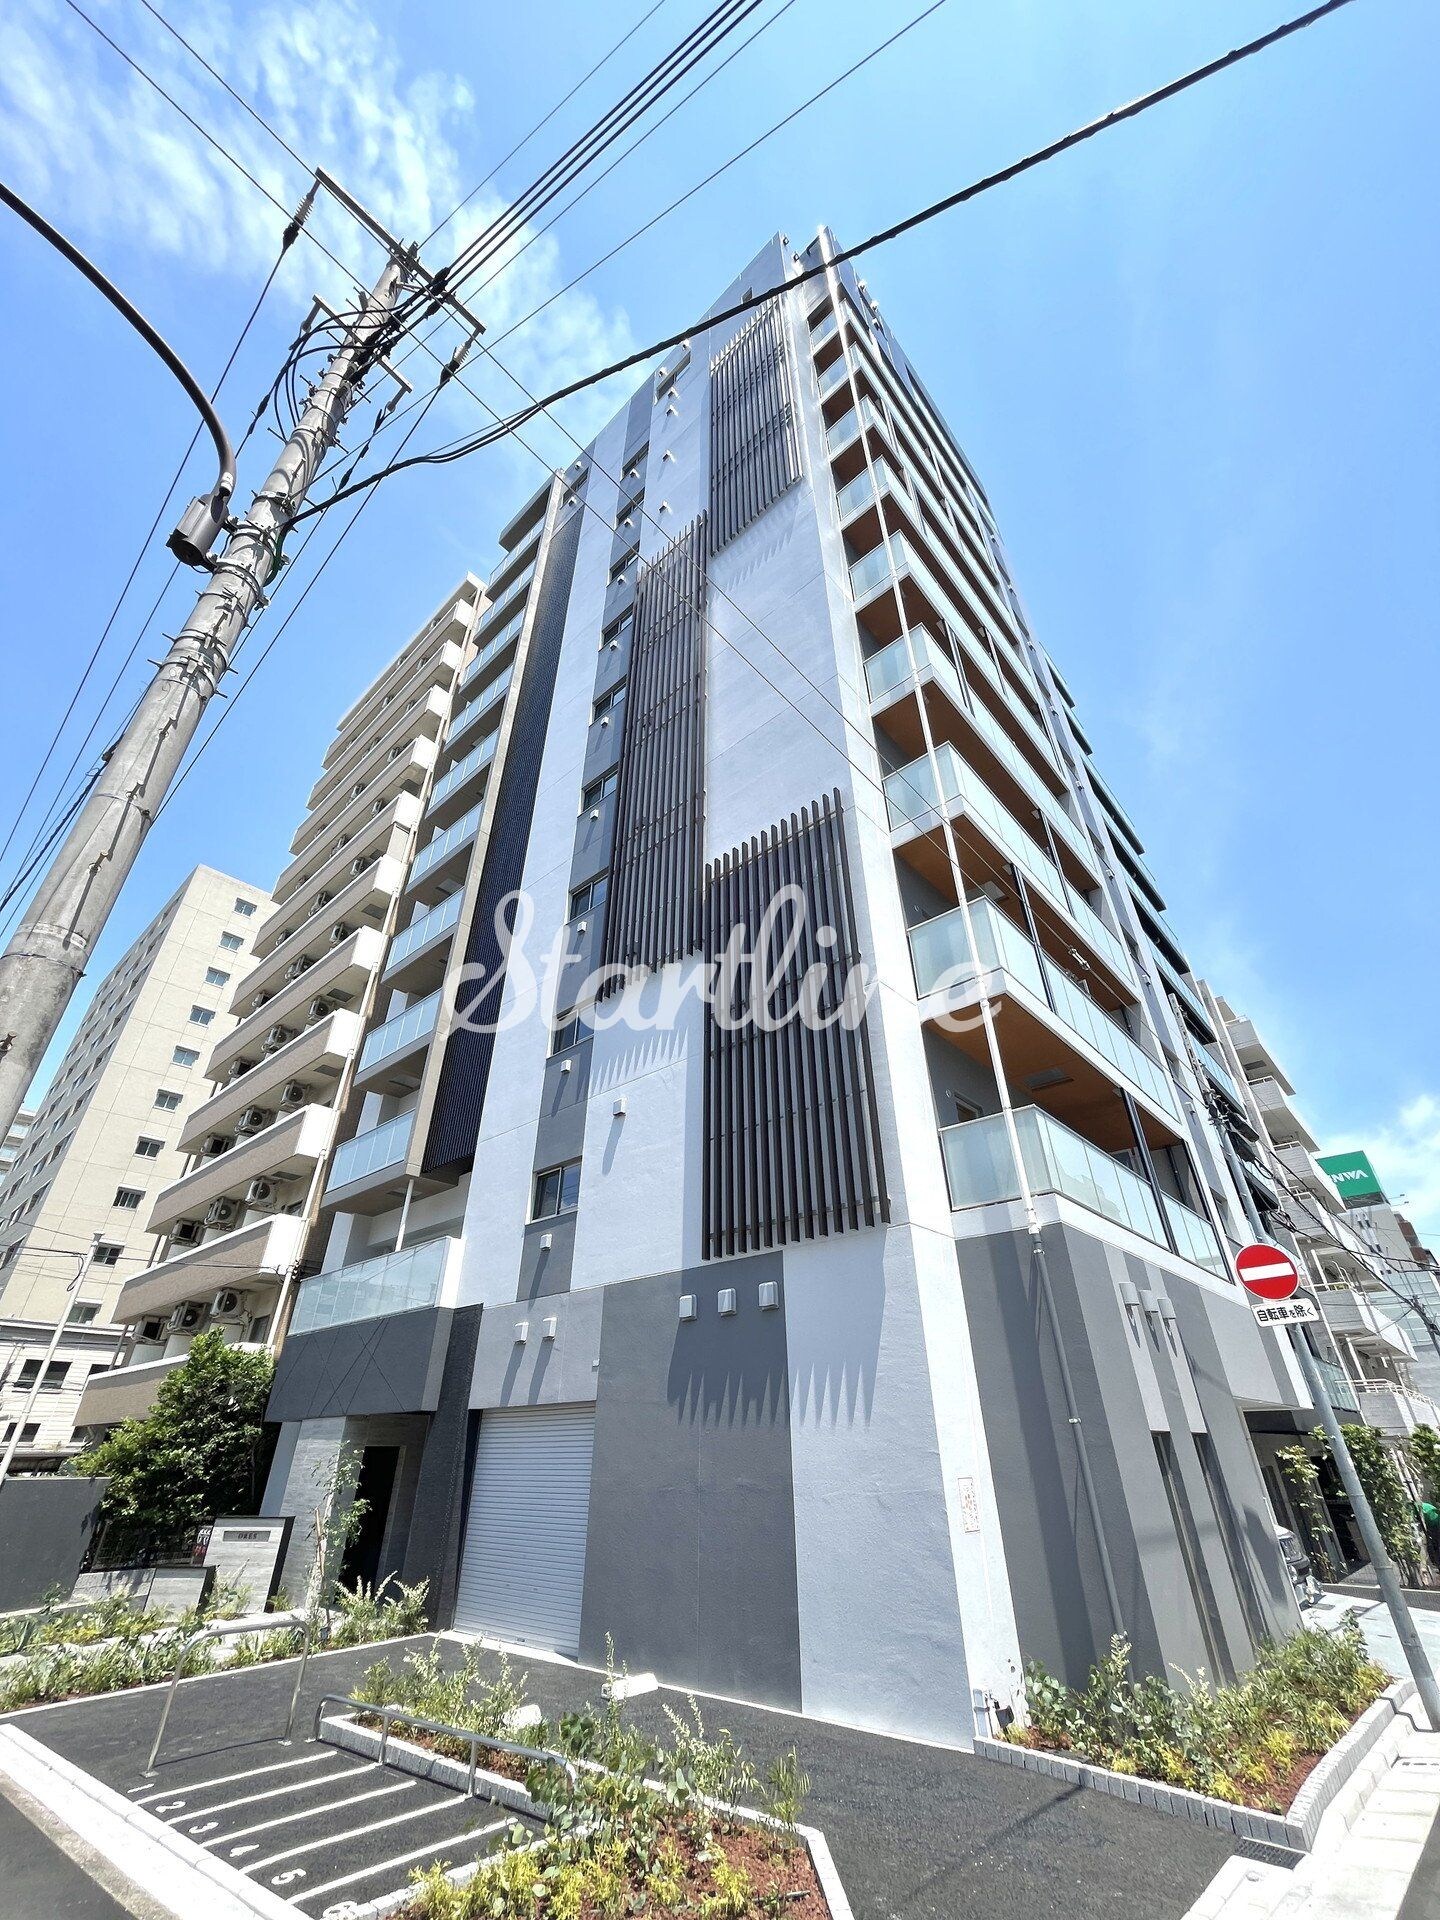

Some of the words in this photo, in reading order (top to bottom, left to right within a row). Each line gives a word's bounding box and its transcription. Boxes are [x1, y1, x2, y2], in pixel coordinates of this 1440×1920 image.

[1257, 1304, 1314, 1322] 自転車を除く
[127, 1783, 155, 1793] 1
[155, 1800, 186, 1813] 2
[188, 1821, 219, 1834] 3
[229, 1844, 260, 1857] 4
[271, 1868, 307, 1885] 5
